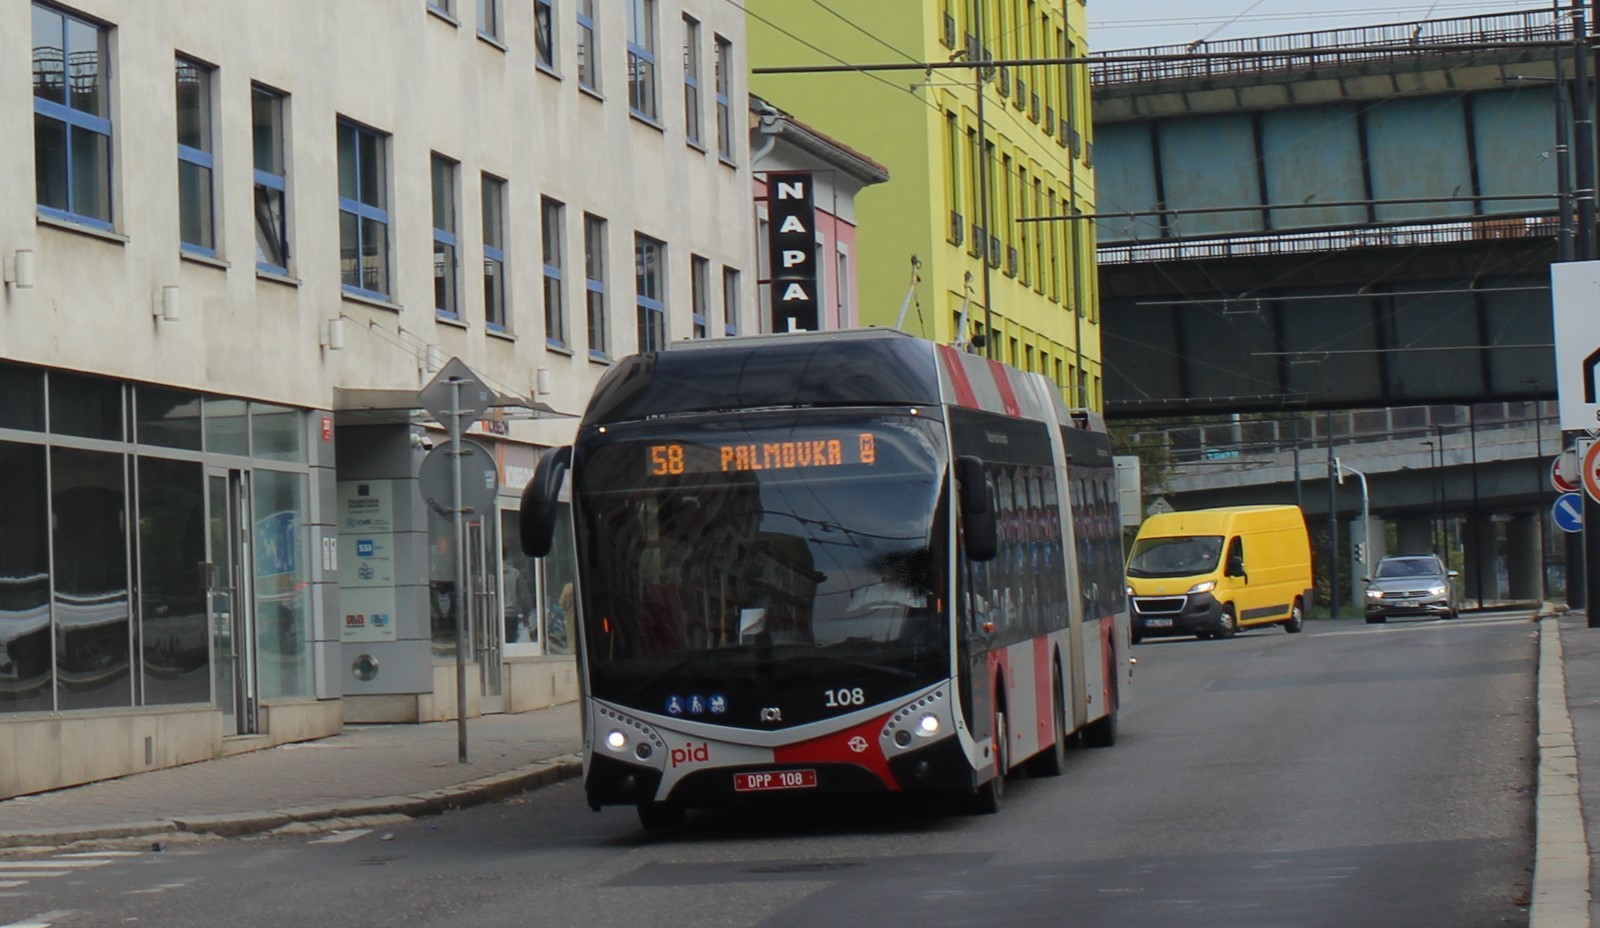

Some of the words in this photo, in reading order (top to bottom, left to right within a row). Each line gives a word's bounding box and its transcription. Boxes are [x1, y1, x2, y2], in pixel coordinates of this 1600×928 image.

[652, 445, 684, 475] 58
[720, 439, 842, 472] PALMOVKA
[824, 687, 865, 707] 108
[671, 742, 710, 768] pid
[748, 773, 772, 788] DPP
[779, 772, 803, 787] 108
